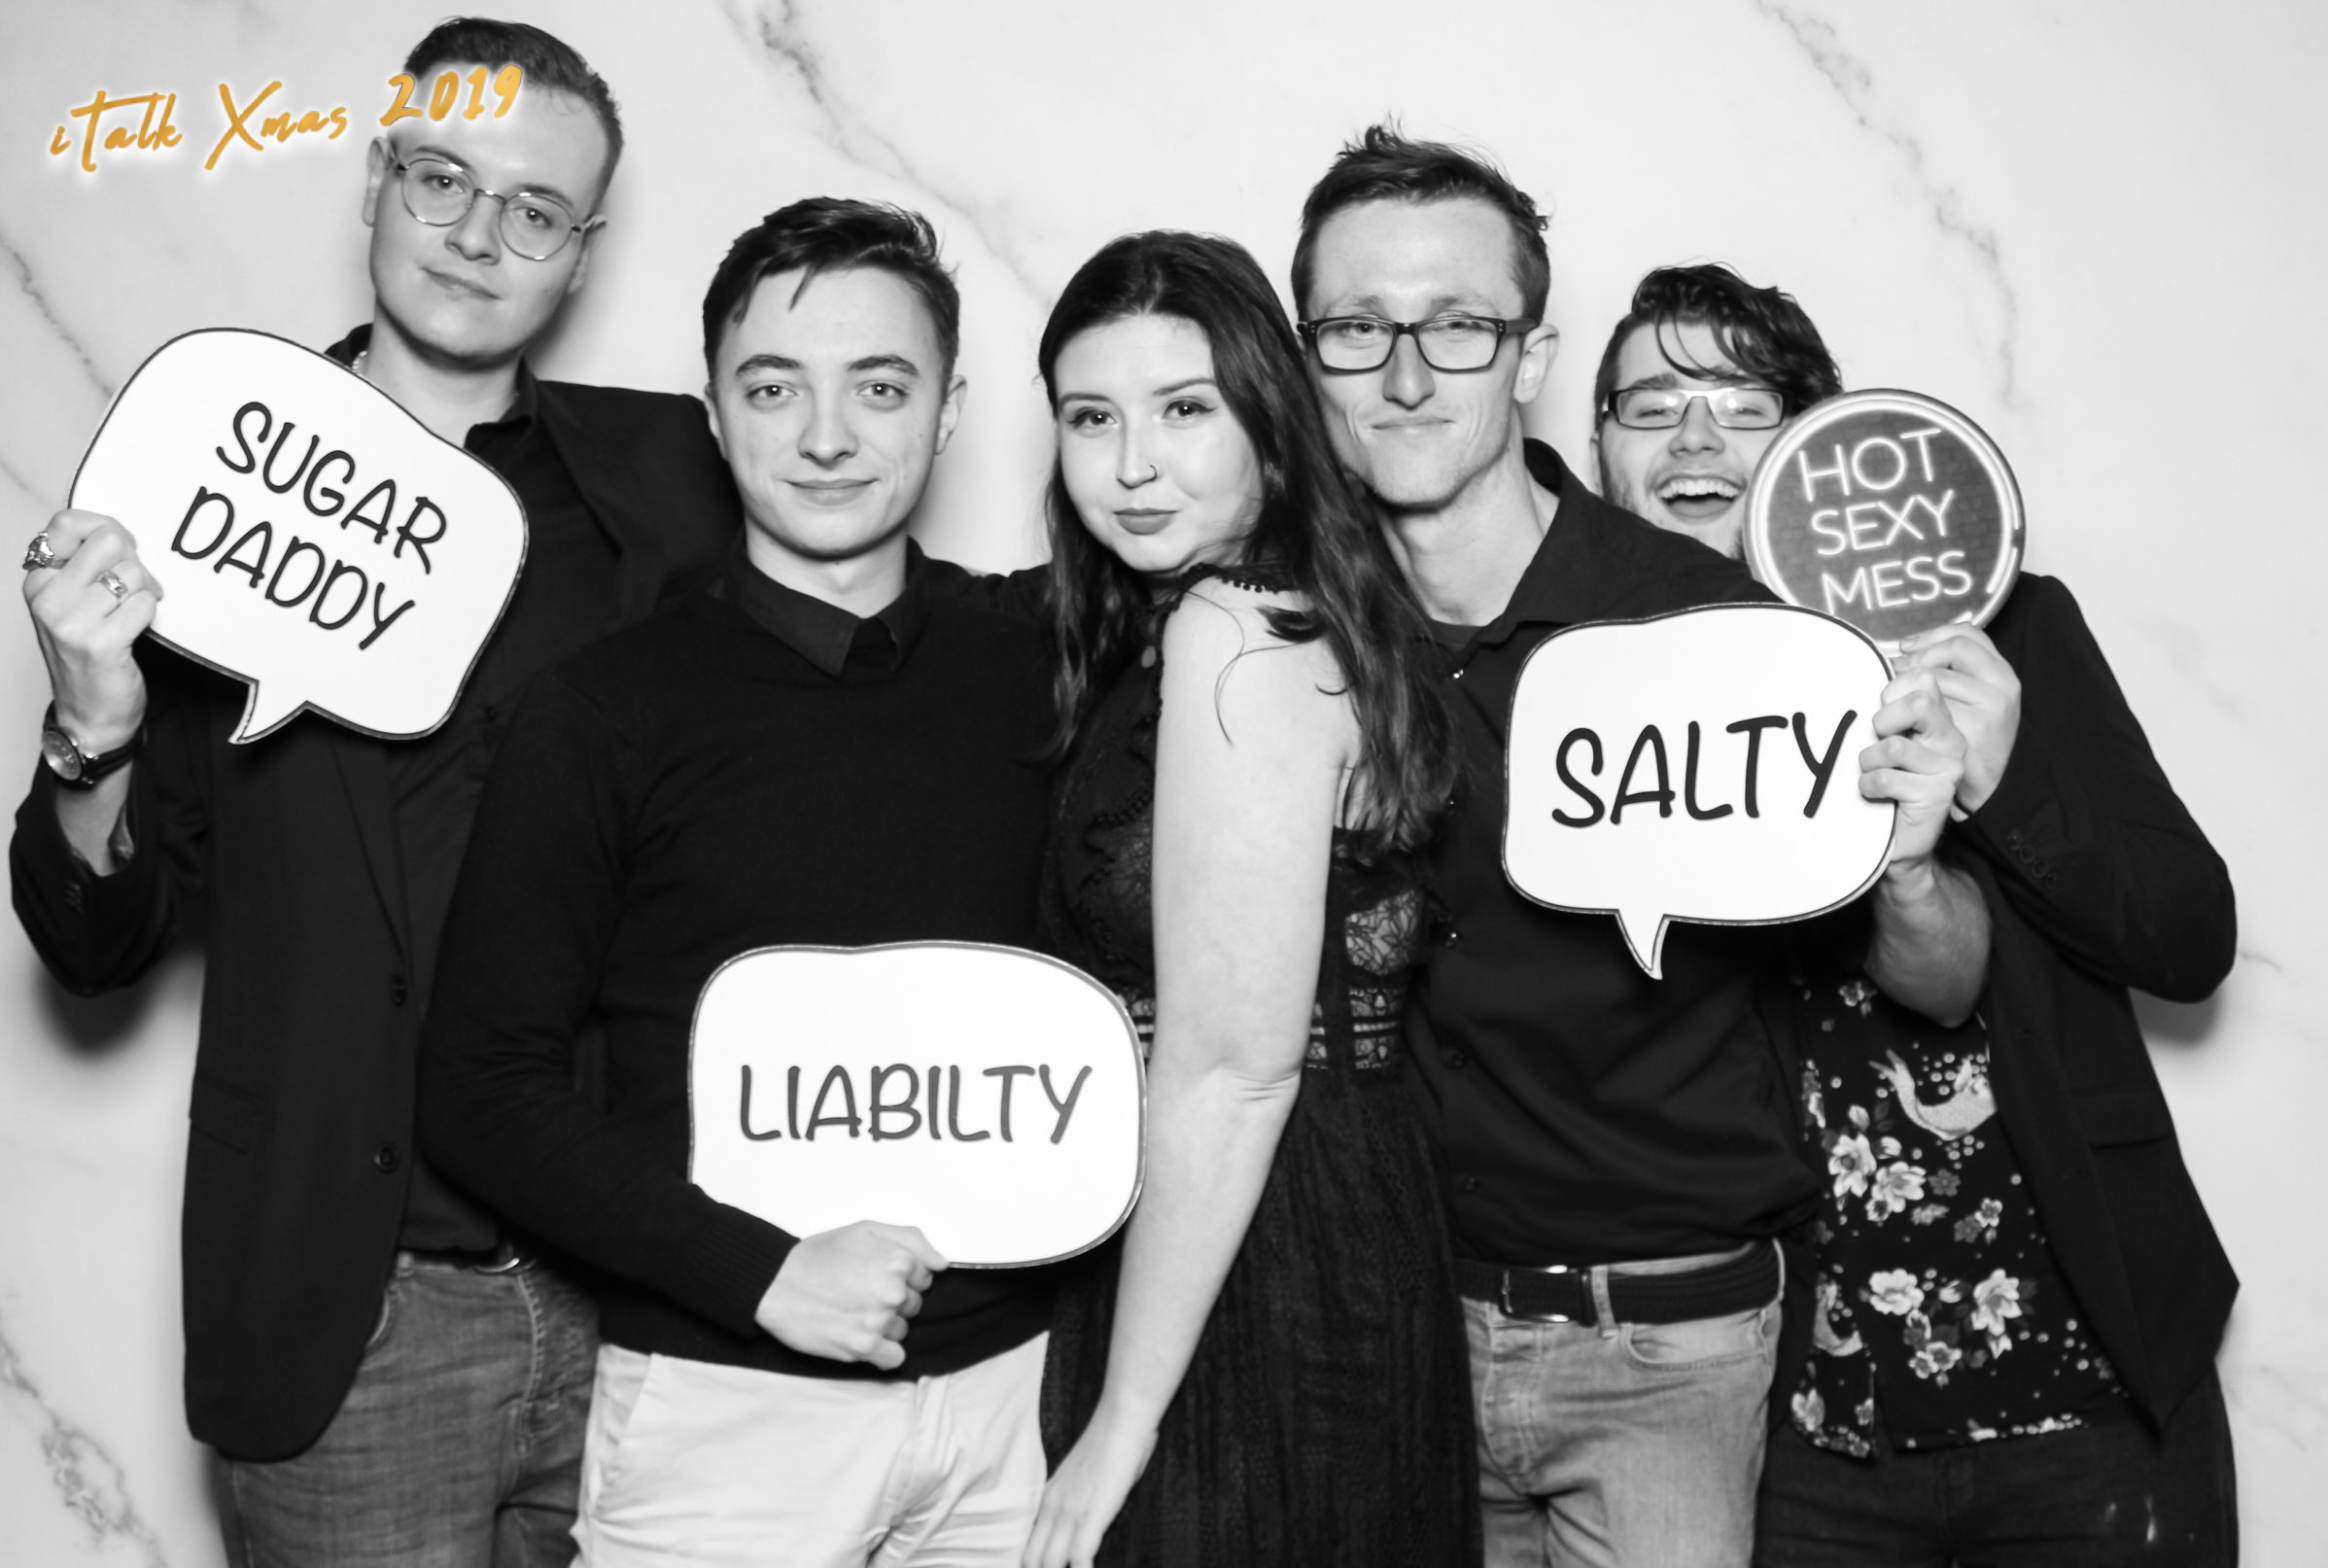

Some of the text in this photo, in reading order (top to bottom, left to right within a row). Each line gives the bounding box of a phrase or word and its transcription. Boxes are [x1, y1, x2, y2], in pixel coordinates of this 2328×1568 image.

[216, 401, 447, 575] SUGAR
[1798, 428, 1942, 502] HOT
[1811, 489, 1954, 556] SEXY
[170, 485, 415, 651] DADDY
[1822, 550, 1973, 615] MESS
[1551, 709, 1858, 827] SALTY
[739, 1063, 1093, 1145] LIABILTY
